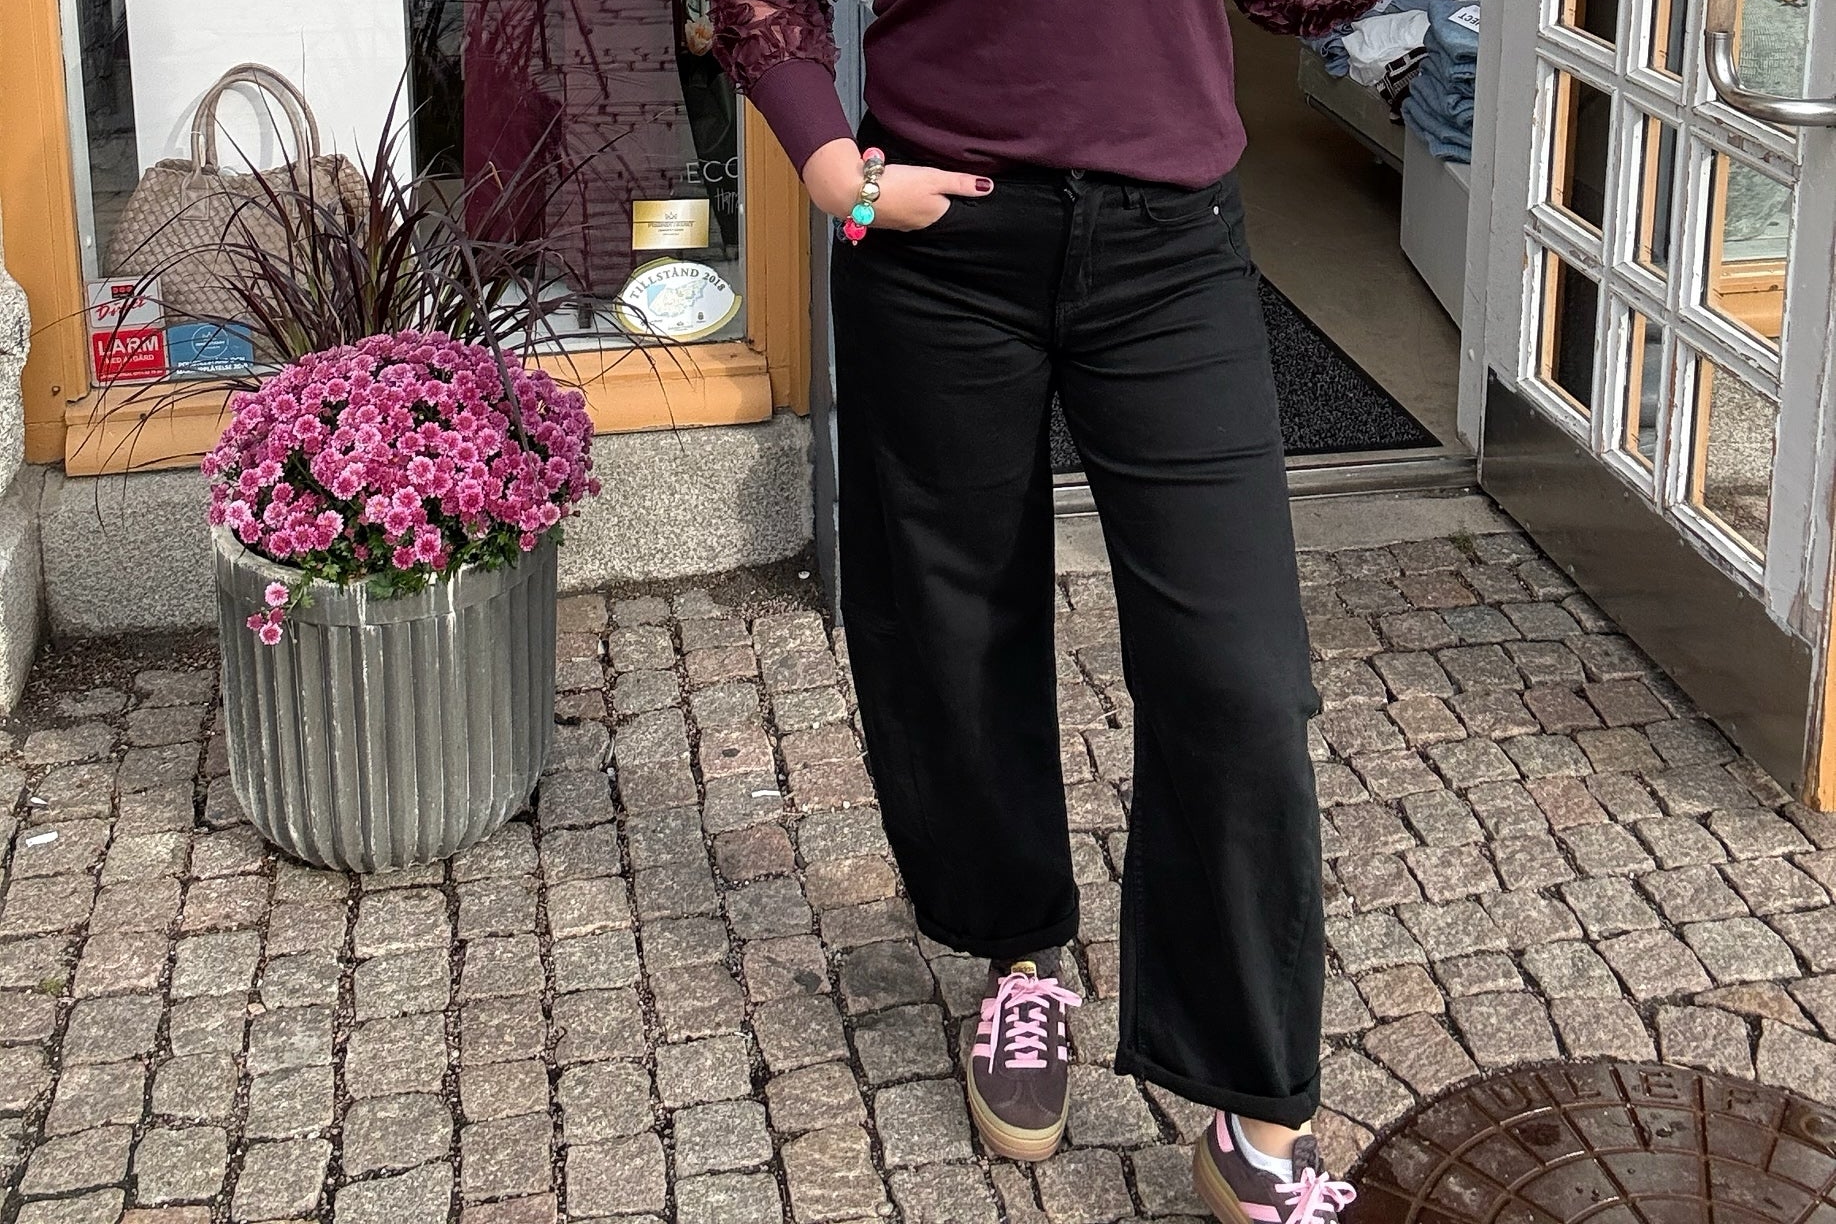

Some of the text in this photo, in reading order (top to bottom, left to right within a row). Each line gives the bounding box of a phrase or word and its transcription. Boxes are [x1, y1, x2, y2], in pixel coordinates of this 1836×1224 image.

[681, 156, 739, 184] ECC
[629, 266, 726, 300] TILLSTÅND 2018
[97, 334, 159, 357] LARM
